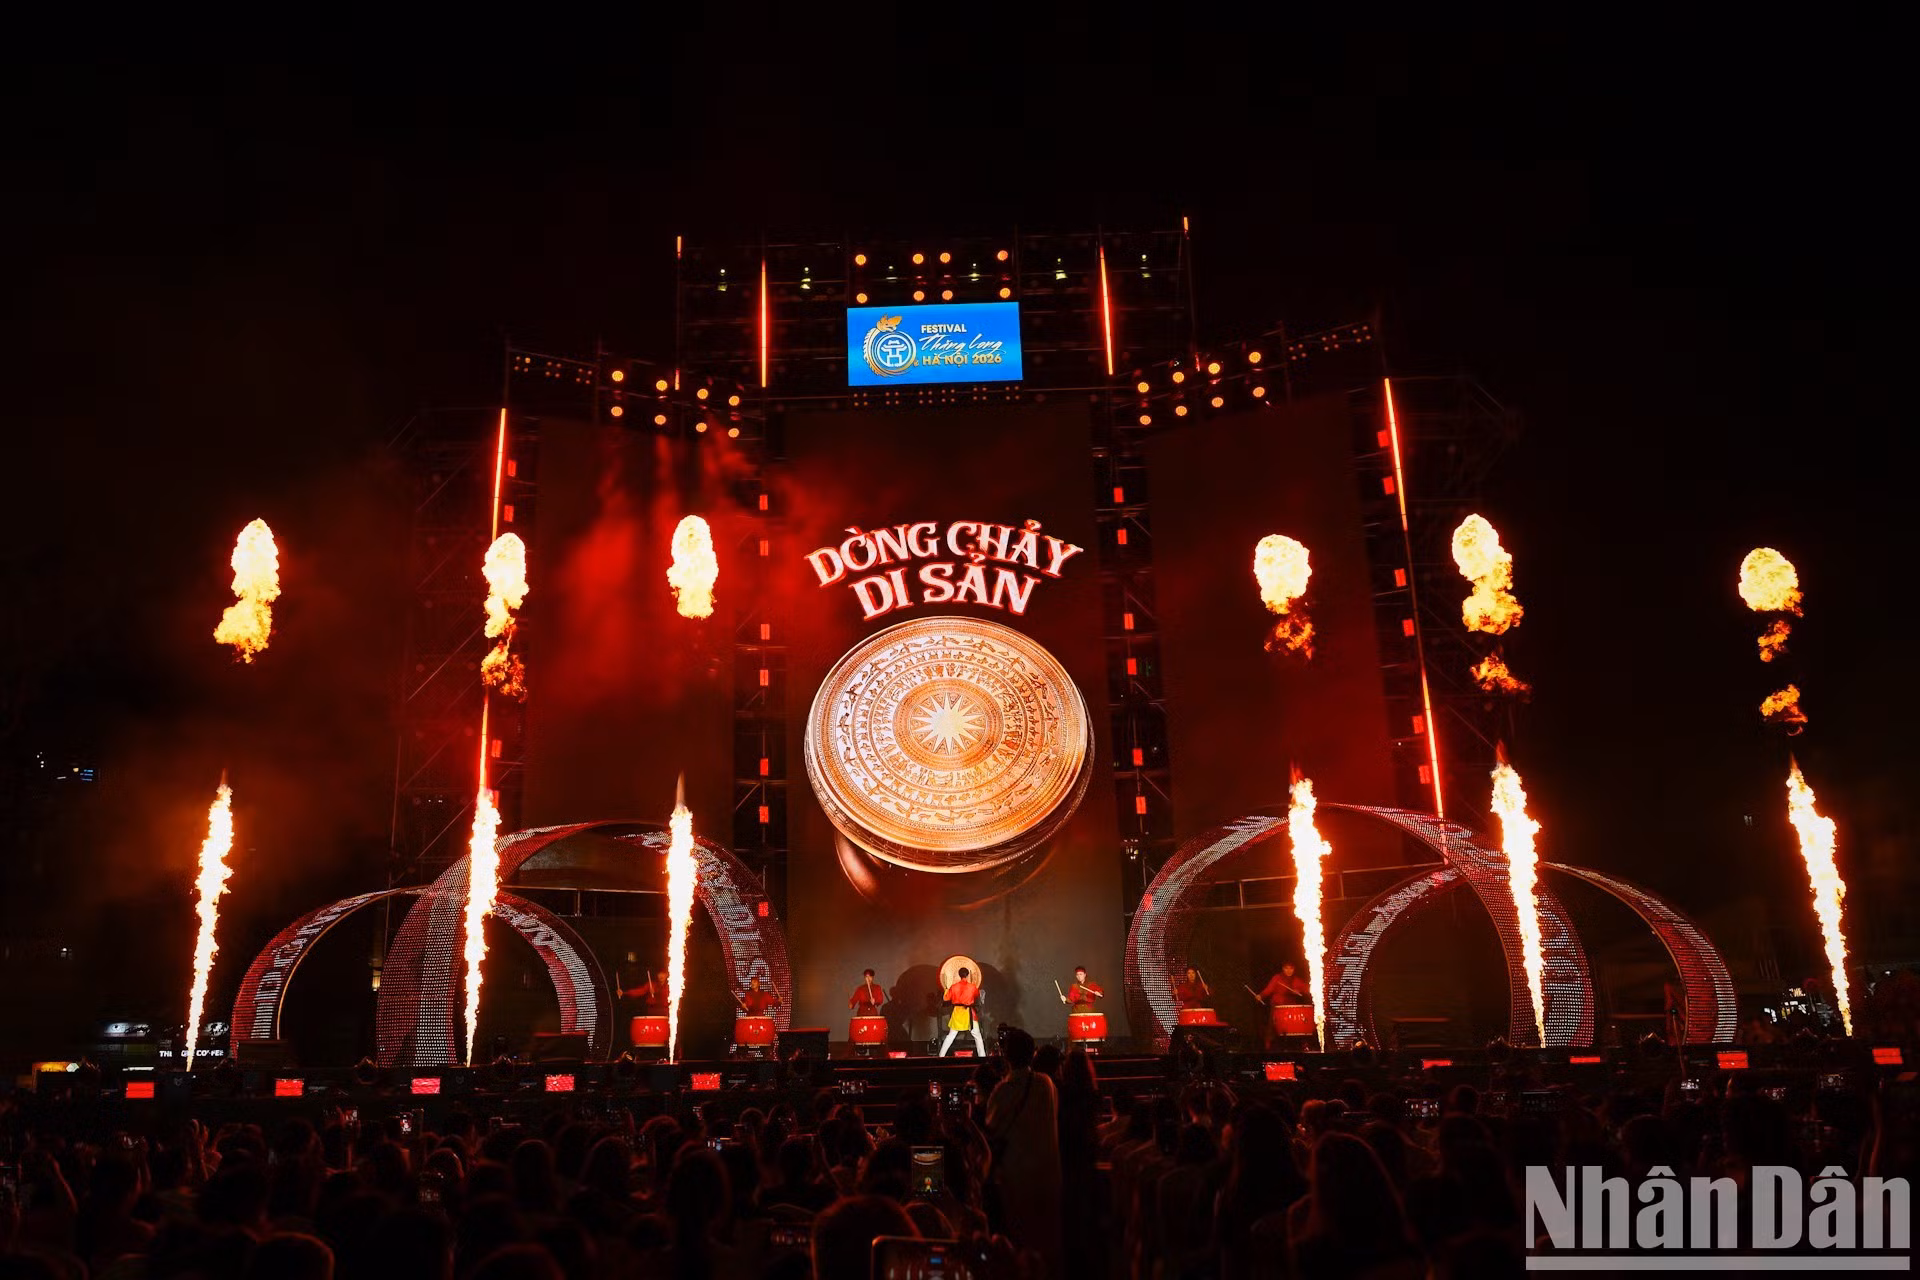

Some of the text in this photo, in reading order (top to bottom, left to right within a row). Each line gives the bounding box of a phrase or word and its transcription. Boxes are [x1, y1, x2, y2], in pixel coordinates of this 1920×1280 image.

[921, 324, 967, 333] FESTIVAL
[923, 352, 1002, 367] HÀ NỘI 2026
[804, 519, 1084, 588] DÒNG CHẢY
[849, 553, 1041, 621] DI SẢN
